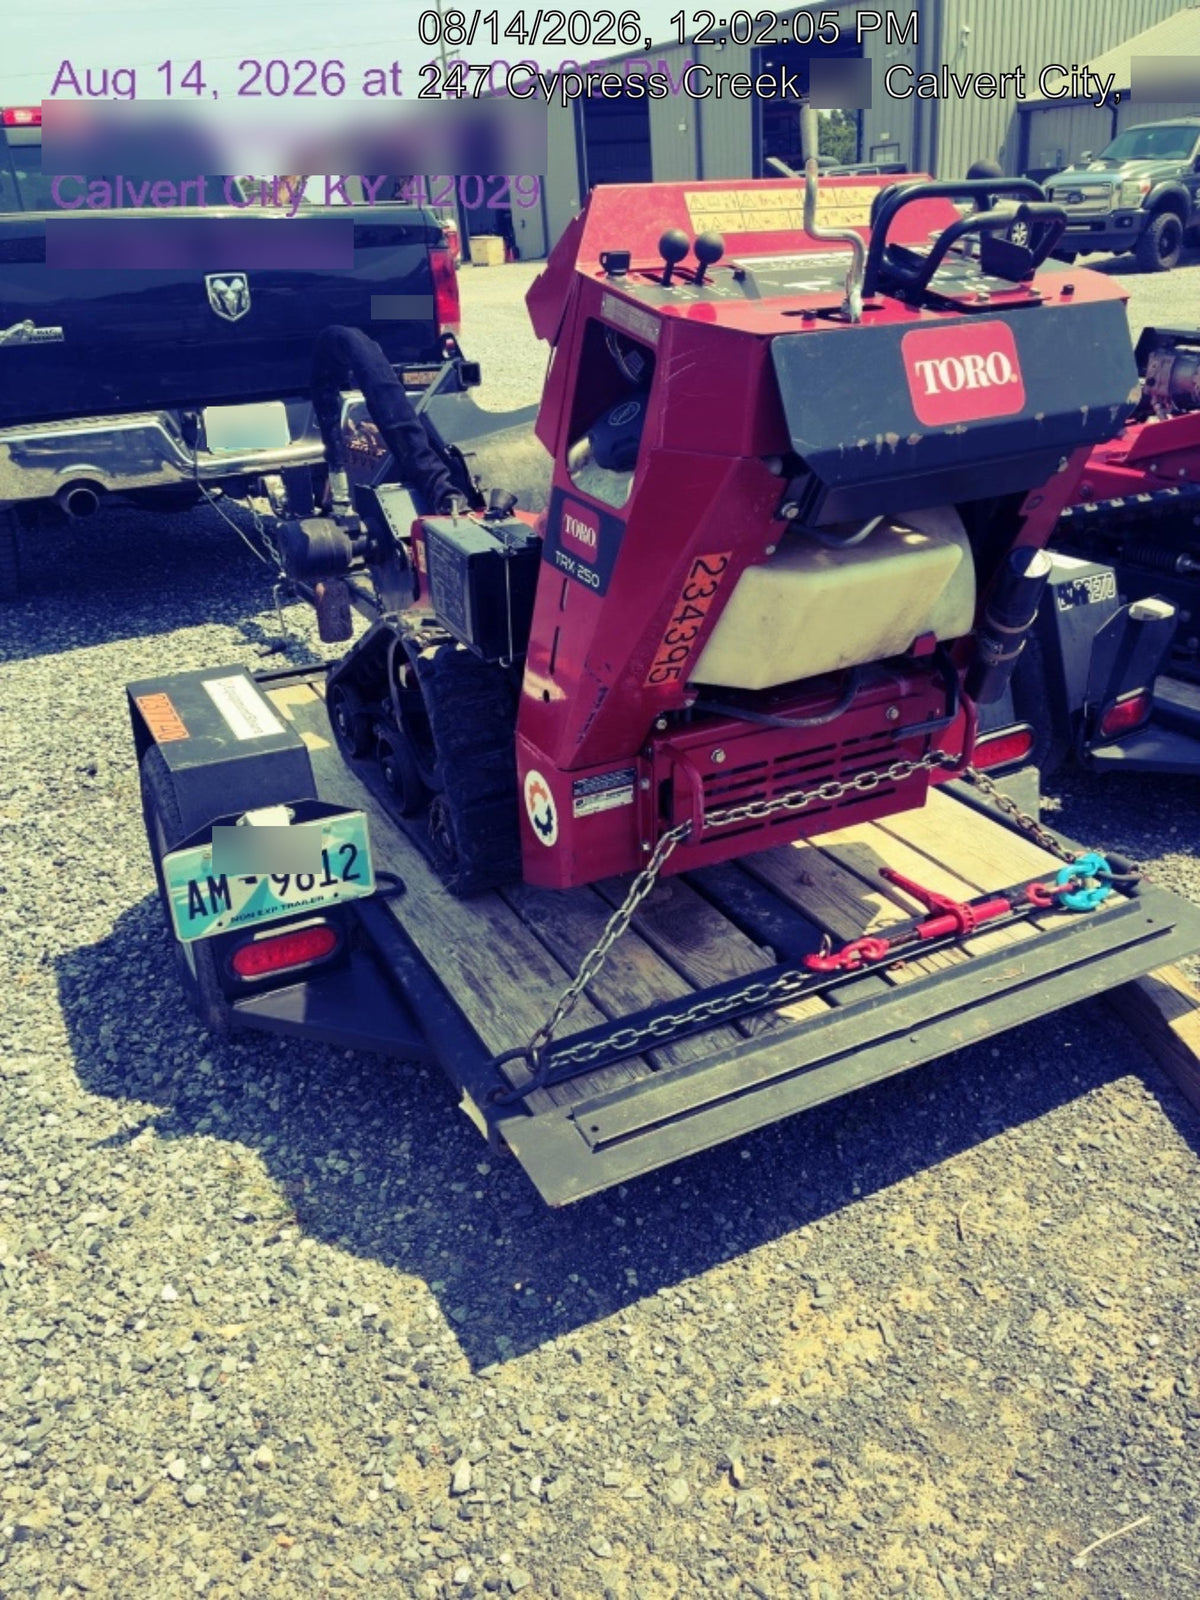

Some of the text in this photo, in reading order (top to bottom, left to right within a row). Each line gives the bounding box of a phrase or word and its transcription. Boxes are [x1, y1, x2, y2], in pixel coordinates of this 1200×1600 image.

[555, 550, 600, 588] TRX 250
[648, 556, 729, 684] 234395
[187, 872, 232, 920] AM
[257, 905, 278, 917] EXP
[281, 895, 325, 912] TRAILER
